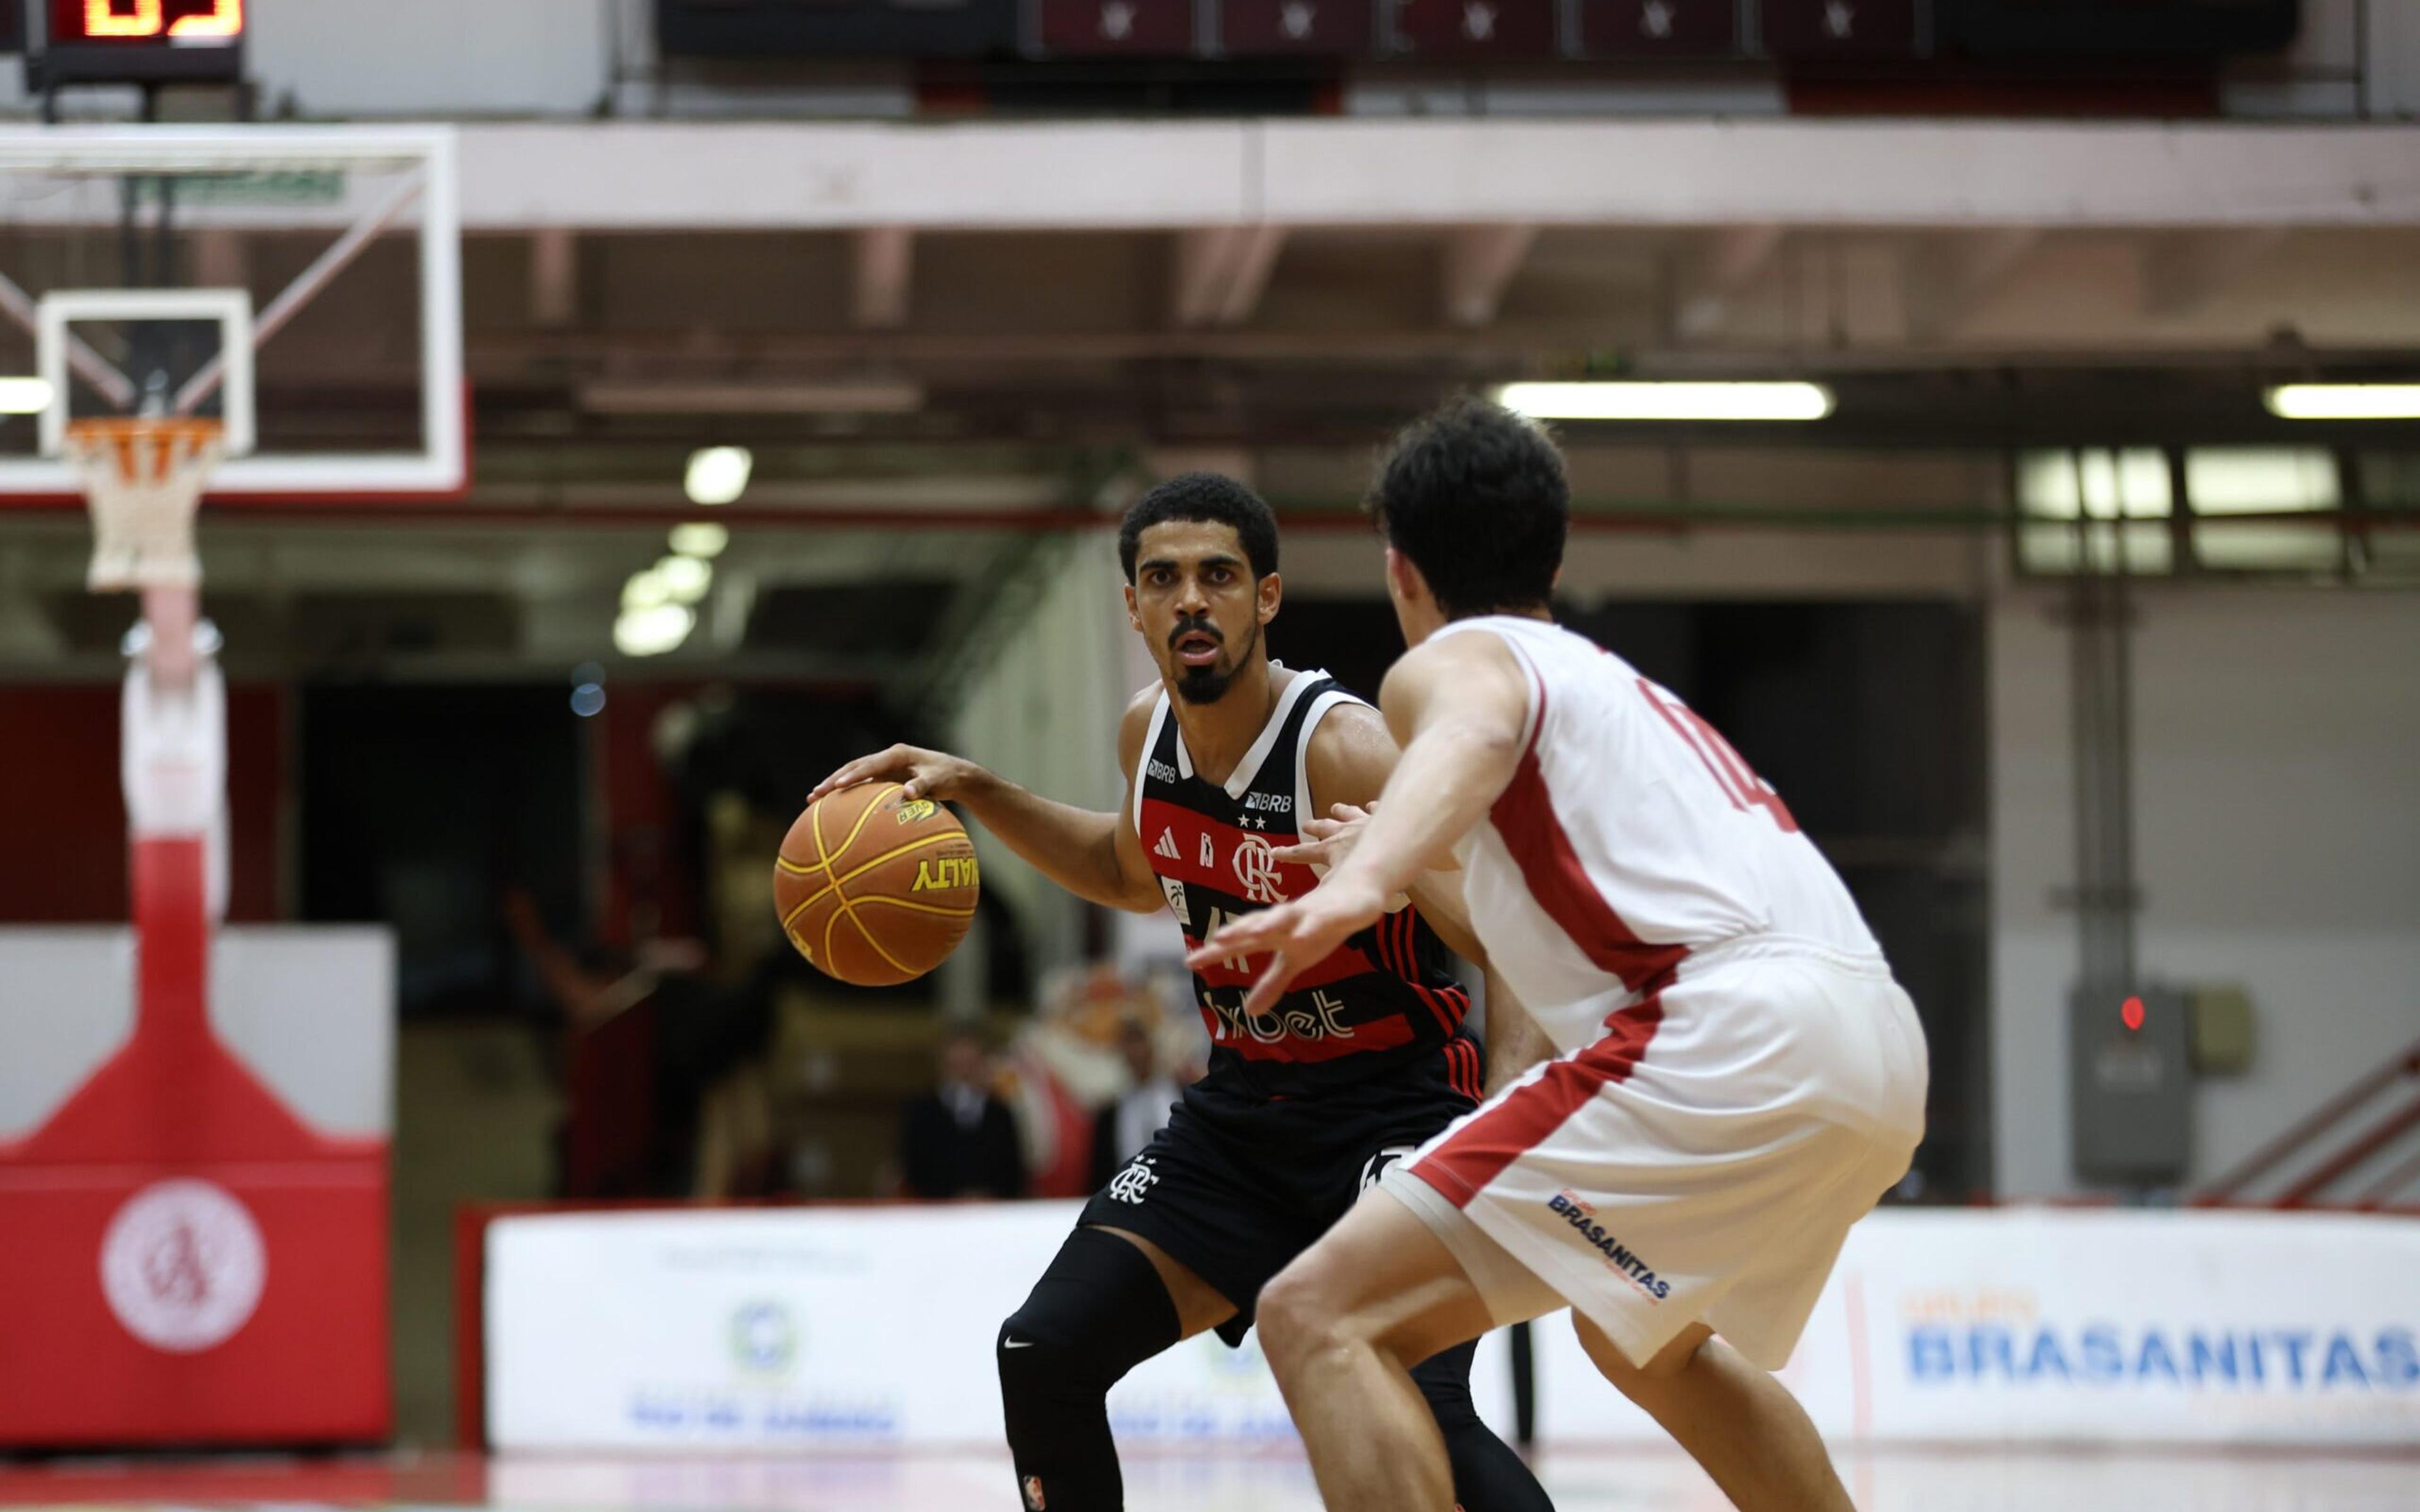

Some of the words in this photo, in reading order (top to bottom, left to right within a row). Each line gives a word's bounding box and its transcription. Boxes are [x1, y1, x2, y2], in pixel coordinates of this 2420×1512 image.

[1156, 764, 1176, 784] BRB
[1260, 793, 1292, 813] BRB
[1548, 1194, 1671, 1300] BRASANITAS
[1908, 1322, 2420, 1383] BRASANITAS
